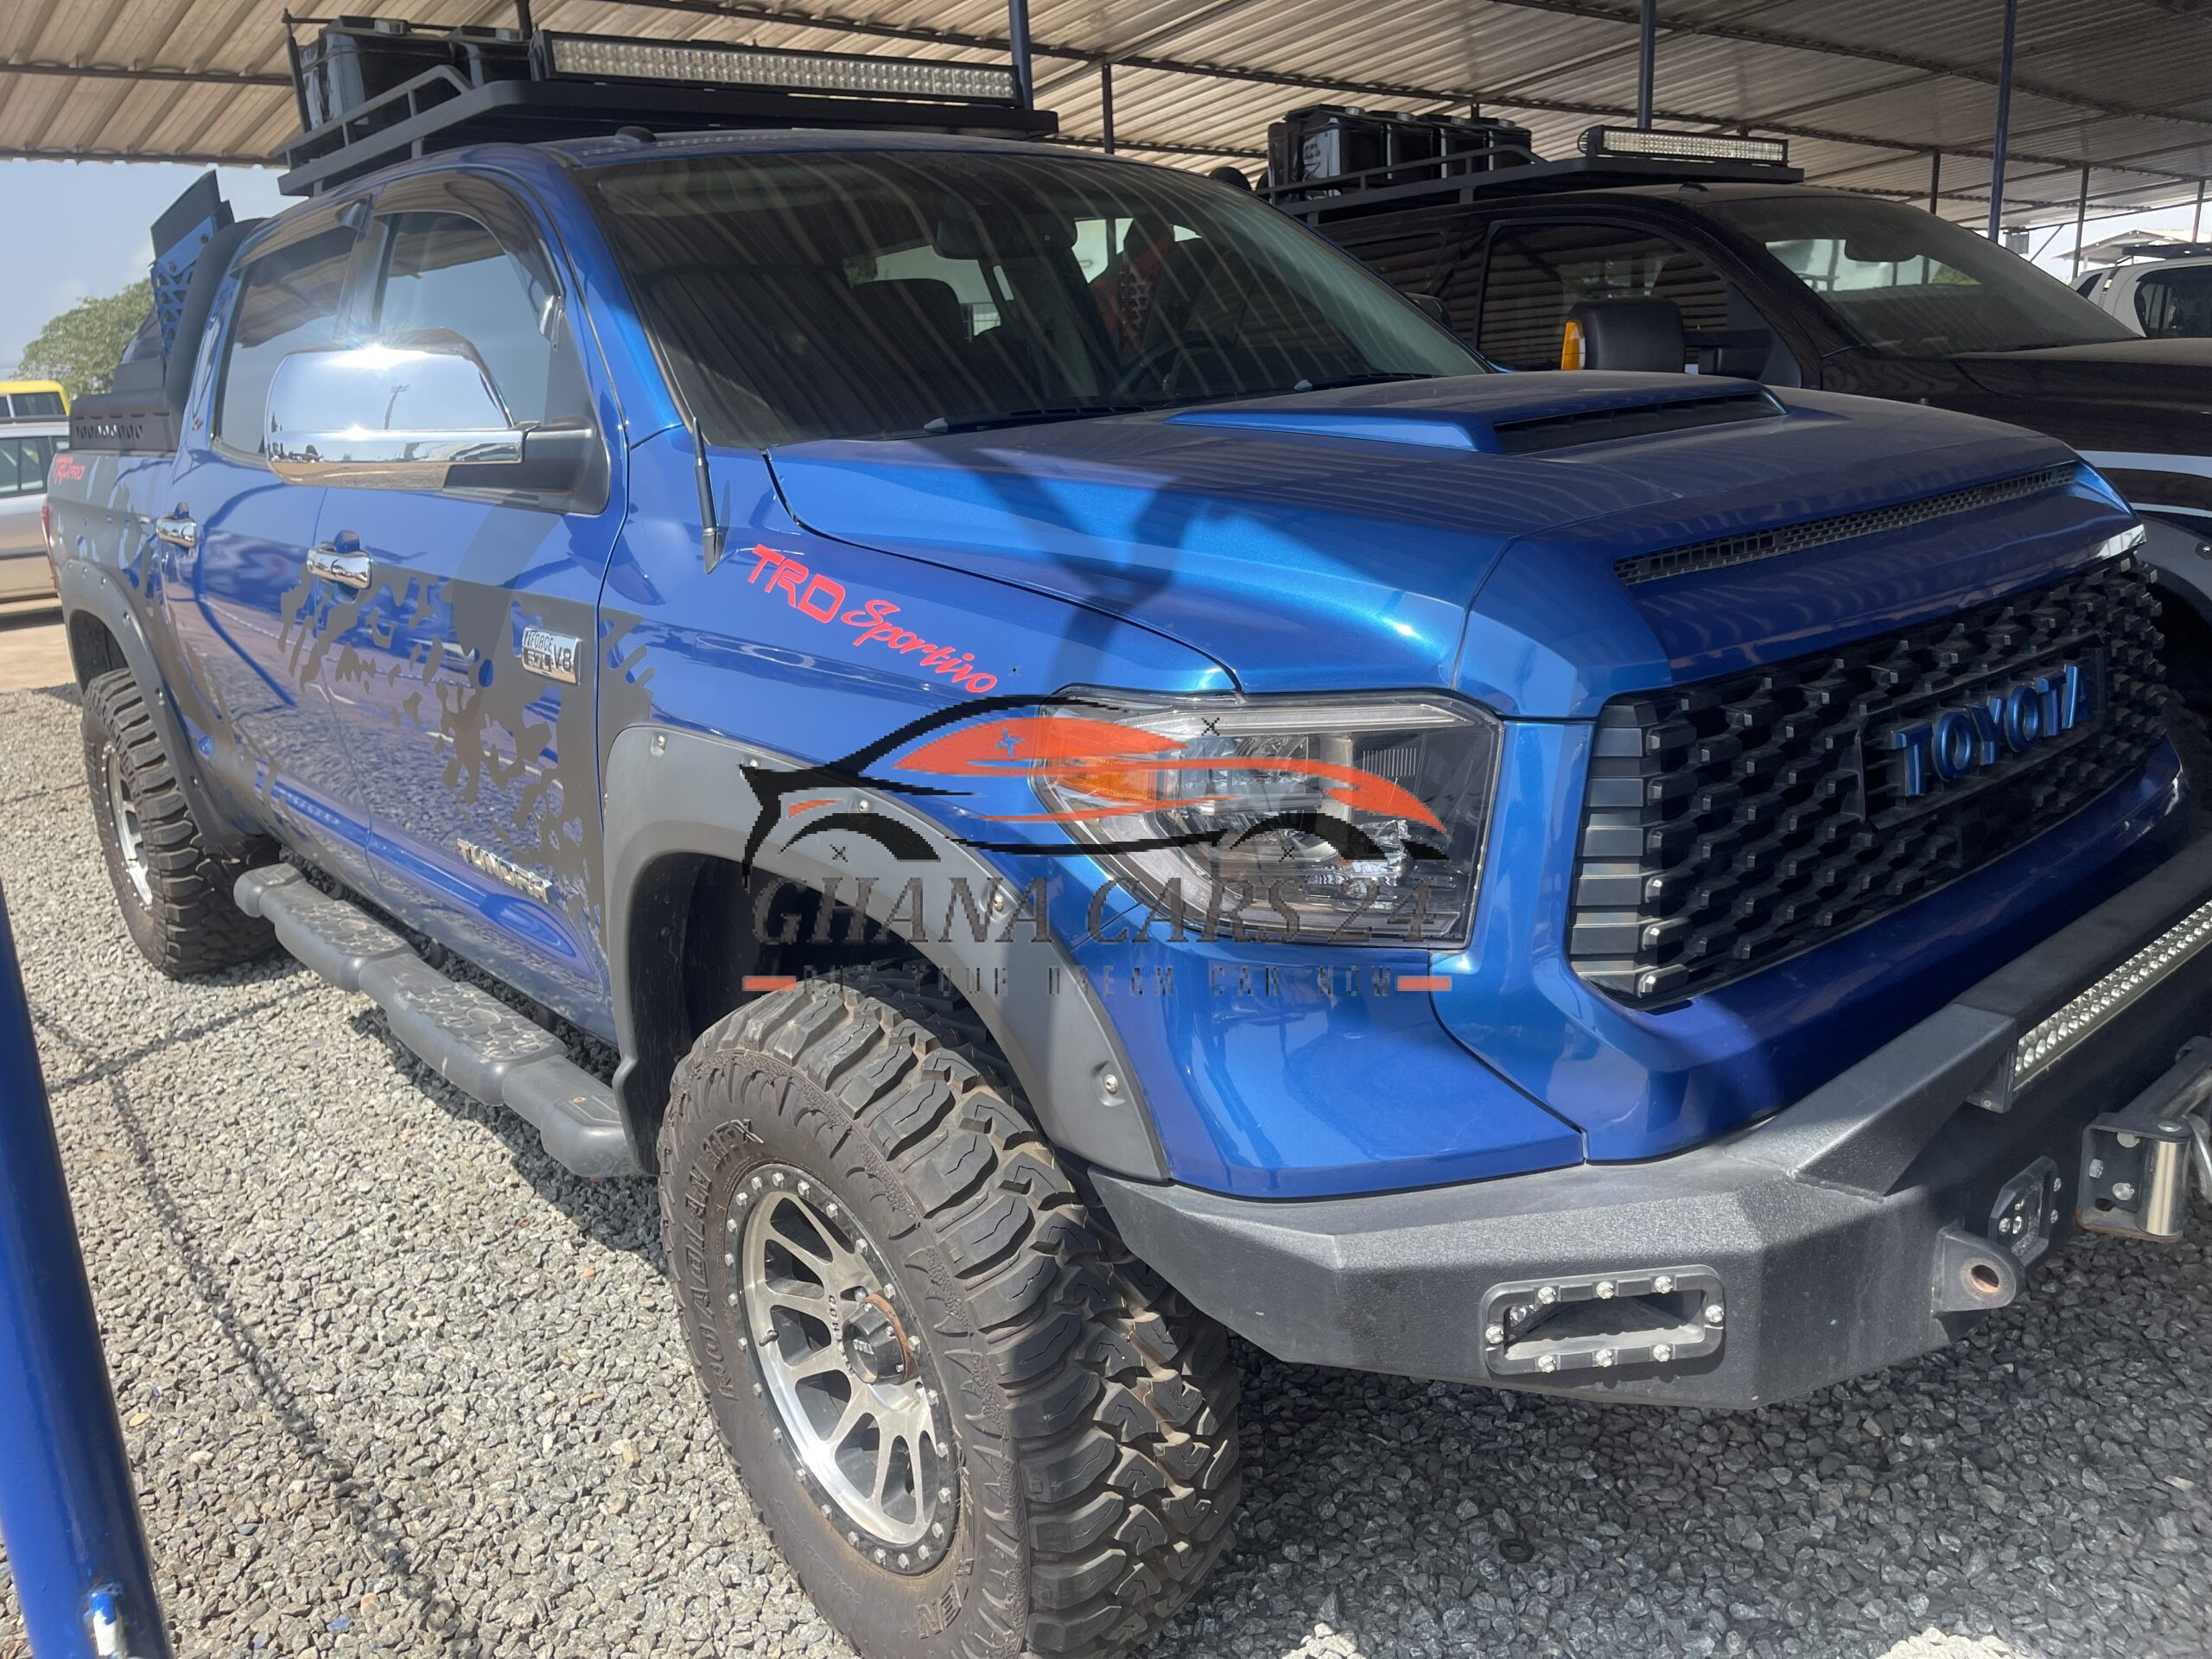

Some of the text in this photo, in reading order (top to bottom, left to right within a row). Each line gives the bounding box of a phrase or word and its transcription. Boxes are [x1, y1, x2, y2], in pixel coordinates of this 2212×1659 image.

[554, 645, 572, 672] V8
[747, 543, 998, 693] TRD Sportivo
[1889, 664, 2091, 798] TOYOTA
[457, 837, 552, 904] TUNDRA
